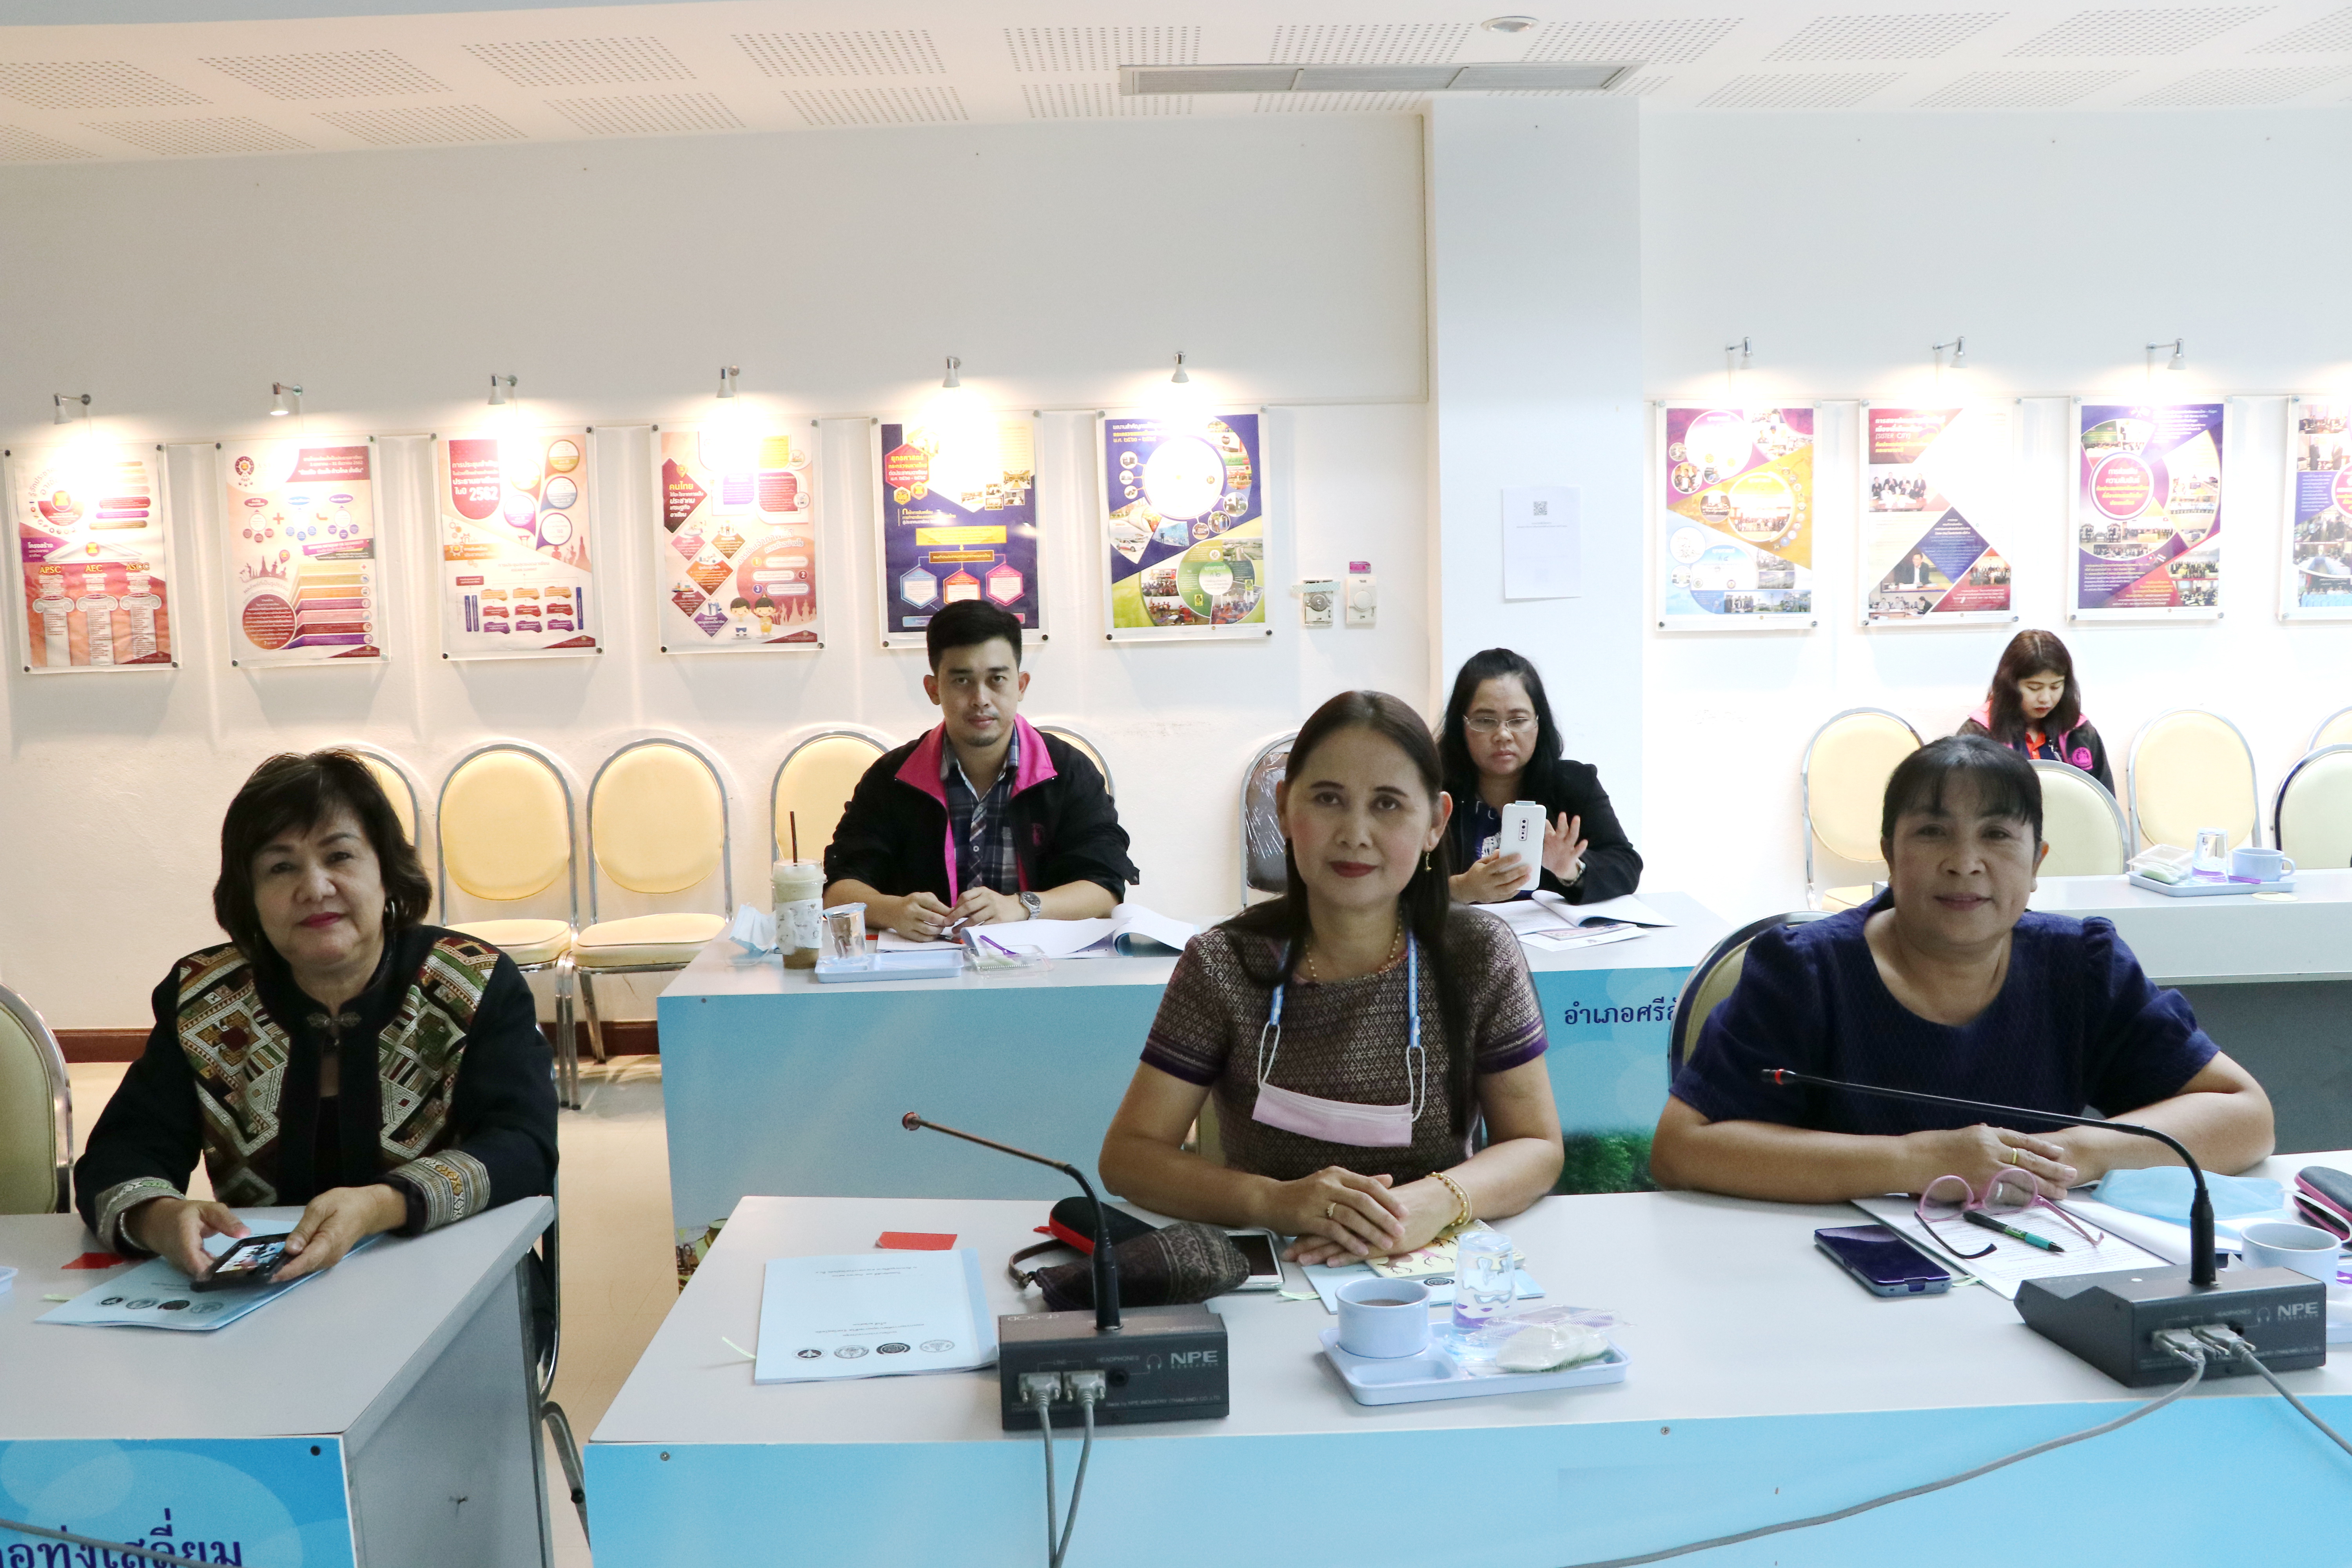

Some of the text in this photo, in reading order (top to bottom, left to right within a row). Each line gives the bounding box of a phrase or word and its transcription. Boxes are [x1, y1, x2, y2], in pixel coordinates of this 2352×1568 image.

[891, 453, 924, 463] ยุทธศาสตร์
[669, 481, 693, 490] คนไทย
[469, 486, 498, 501] 2562
[765, 538, 804, 554] ควรทำอย่างไร
[125, 562, 150, 571] ASCC
[2278, 1302, 2318, 1316] NPE
[1171, 1351, 1218, 1364] NPE
